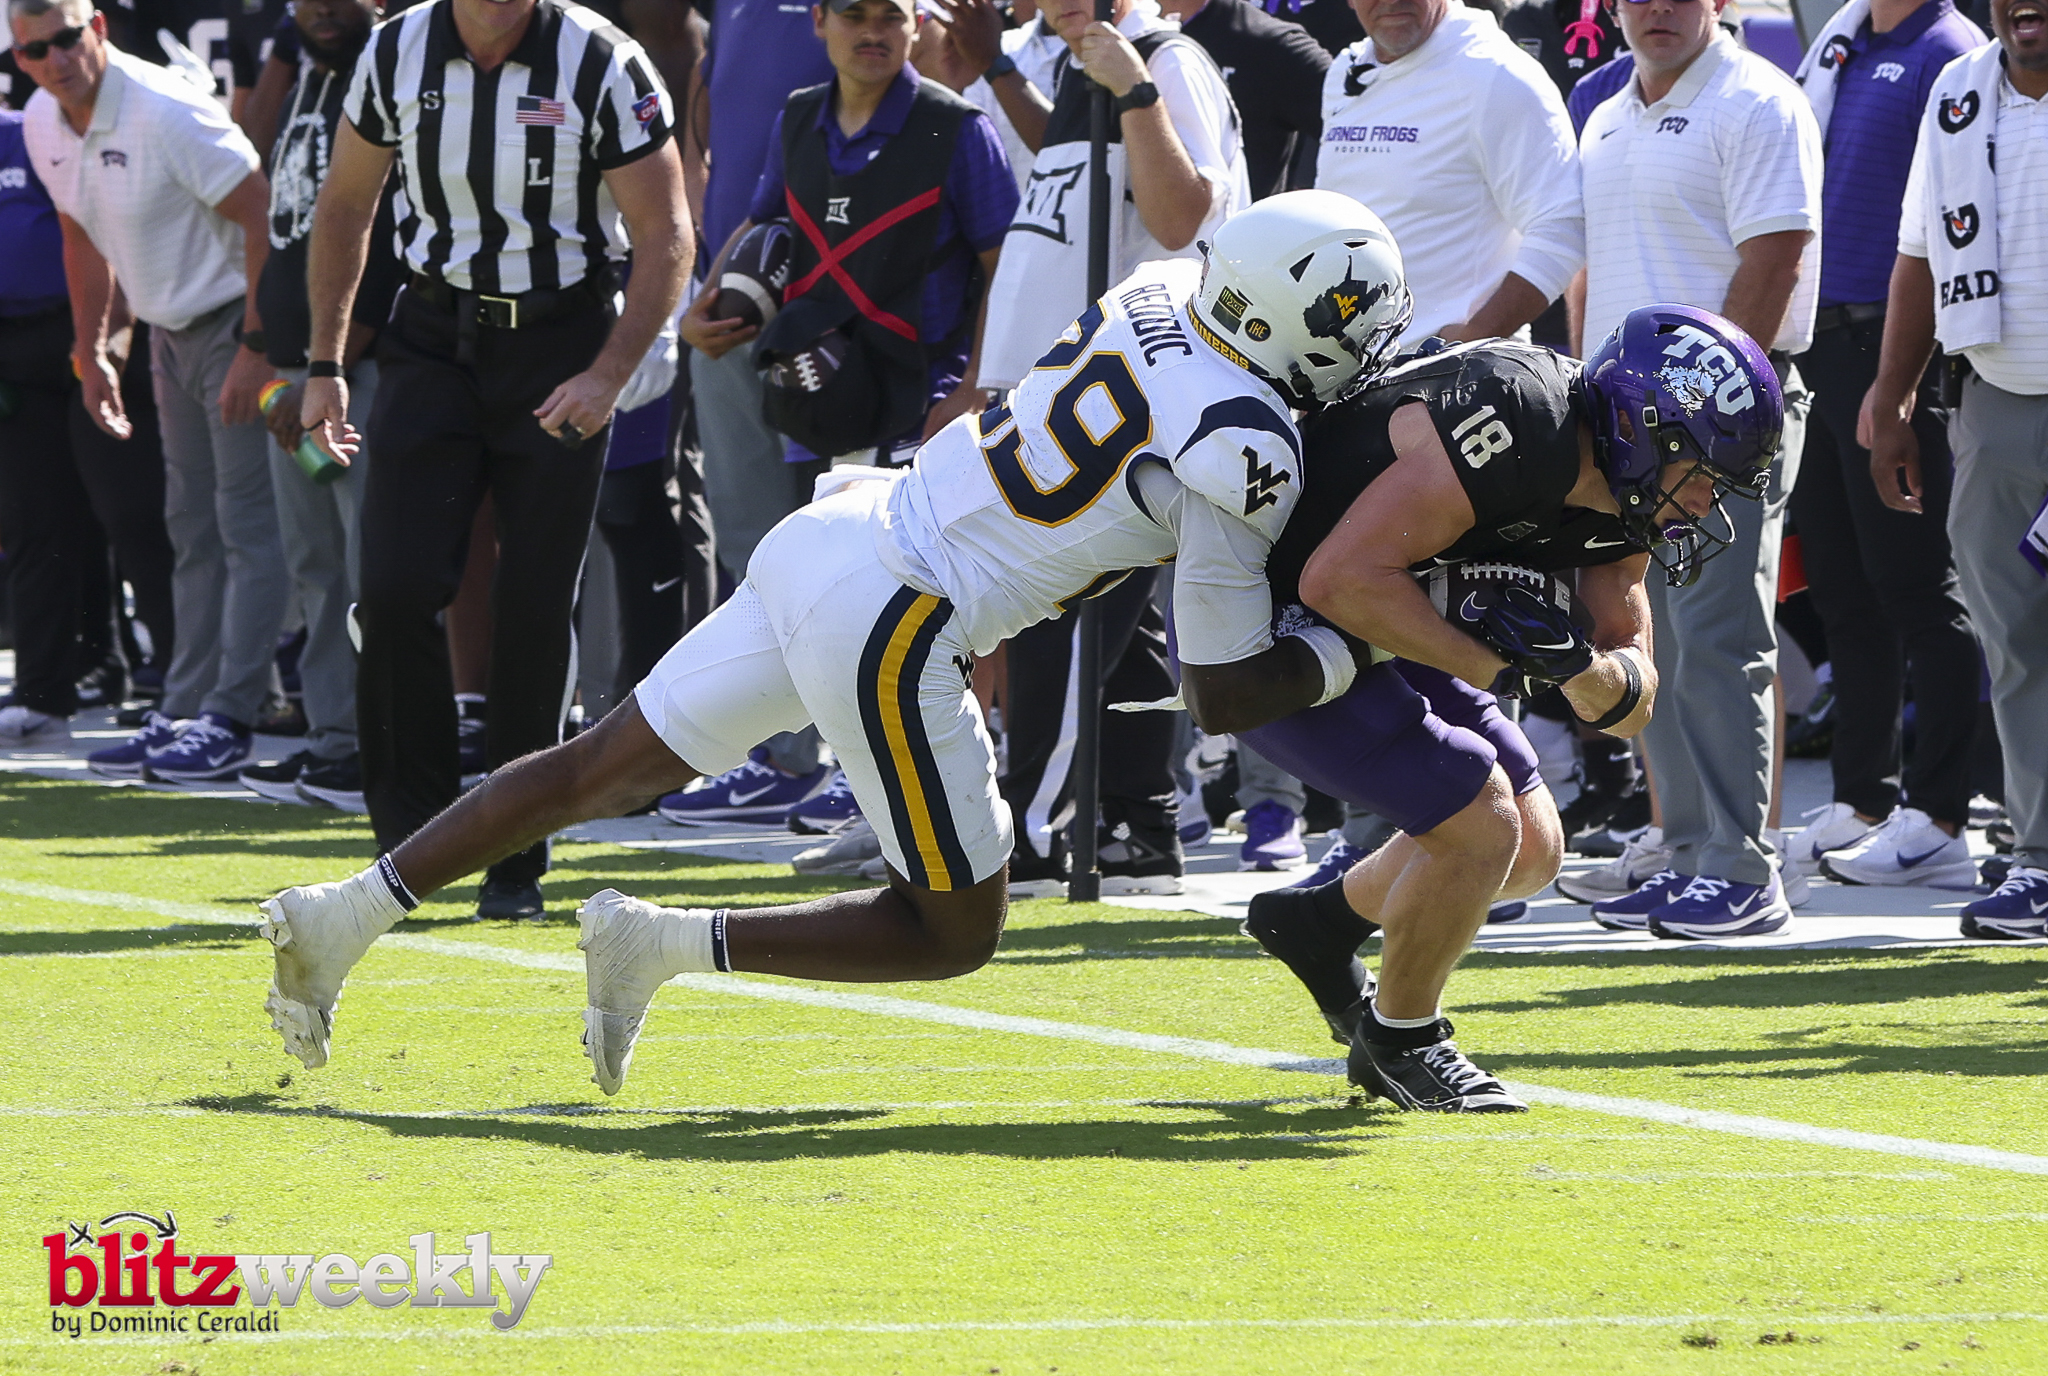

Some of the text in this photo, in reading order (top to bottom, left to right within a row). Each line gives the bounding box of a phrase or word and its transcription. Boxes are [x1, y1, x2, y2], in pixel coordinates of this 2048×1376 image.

[422, 90, 440, 110] S
[1370, 126, 1419, 143] FROGS
[1656, 116, 1689, 135] TCU
[1335, 146, 1391, 154] FOOTBALL
[527, 157, 551, 186] L
[1661, 324, 1756, 416] TCU
[1451, 404, 1514, 470] 18
